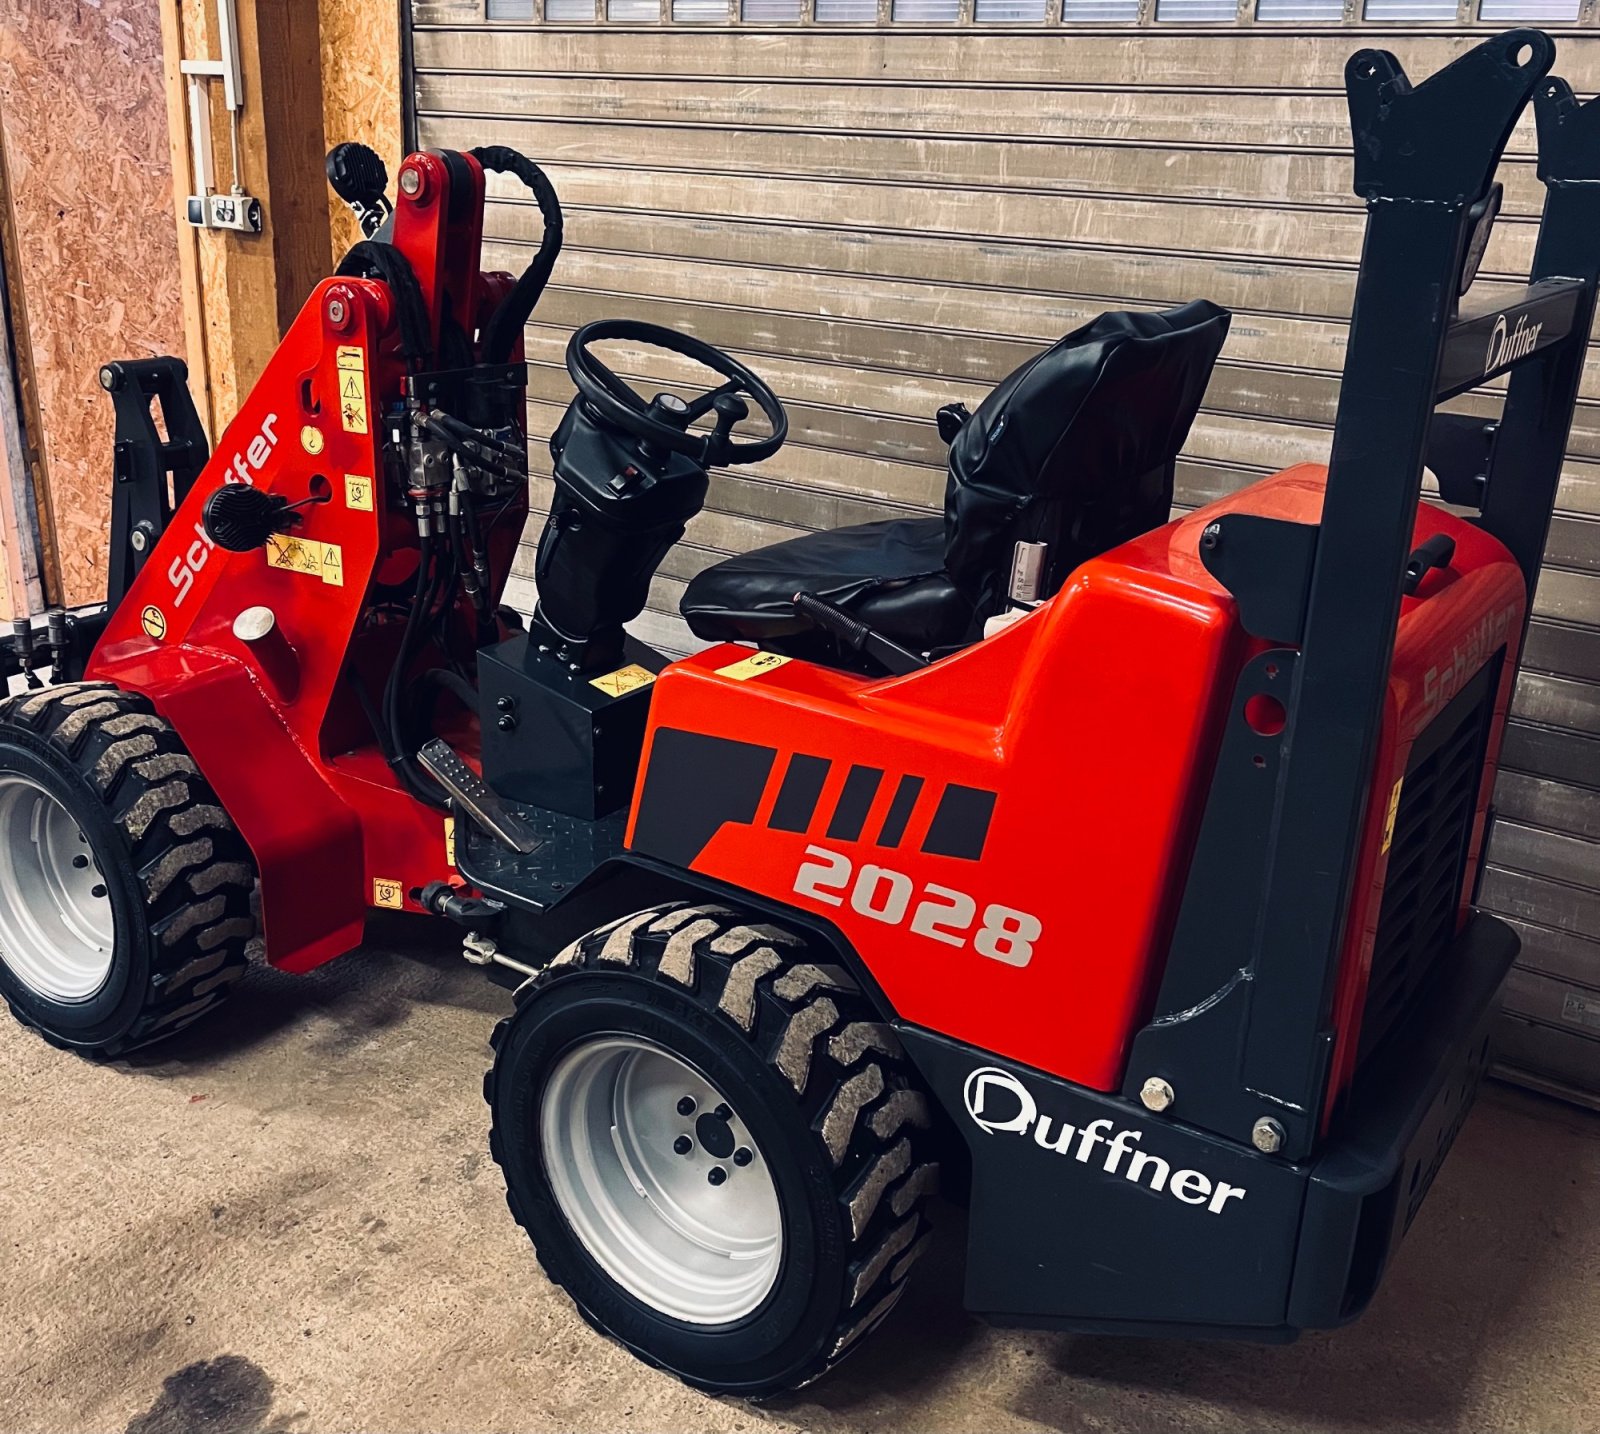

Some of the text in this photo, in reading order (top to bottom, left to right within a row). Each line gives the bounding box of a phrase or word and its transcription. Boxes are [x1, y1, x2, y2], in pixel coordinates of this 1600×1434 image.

[1484, 314, 1543, 377] Duffner
[793, 844, 1042, 968] 2028
[963, 1066, 1246, 1214] Duffner
